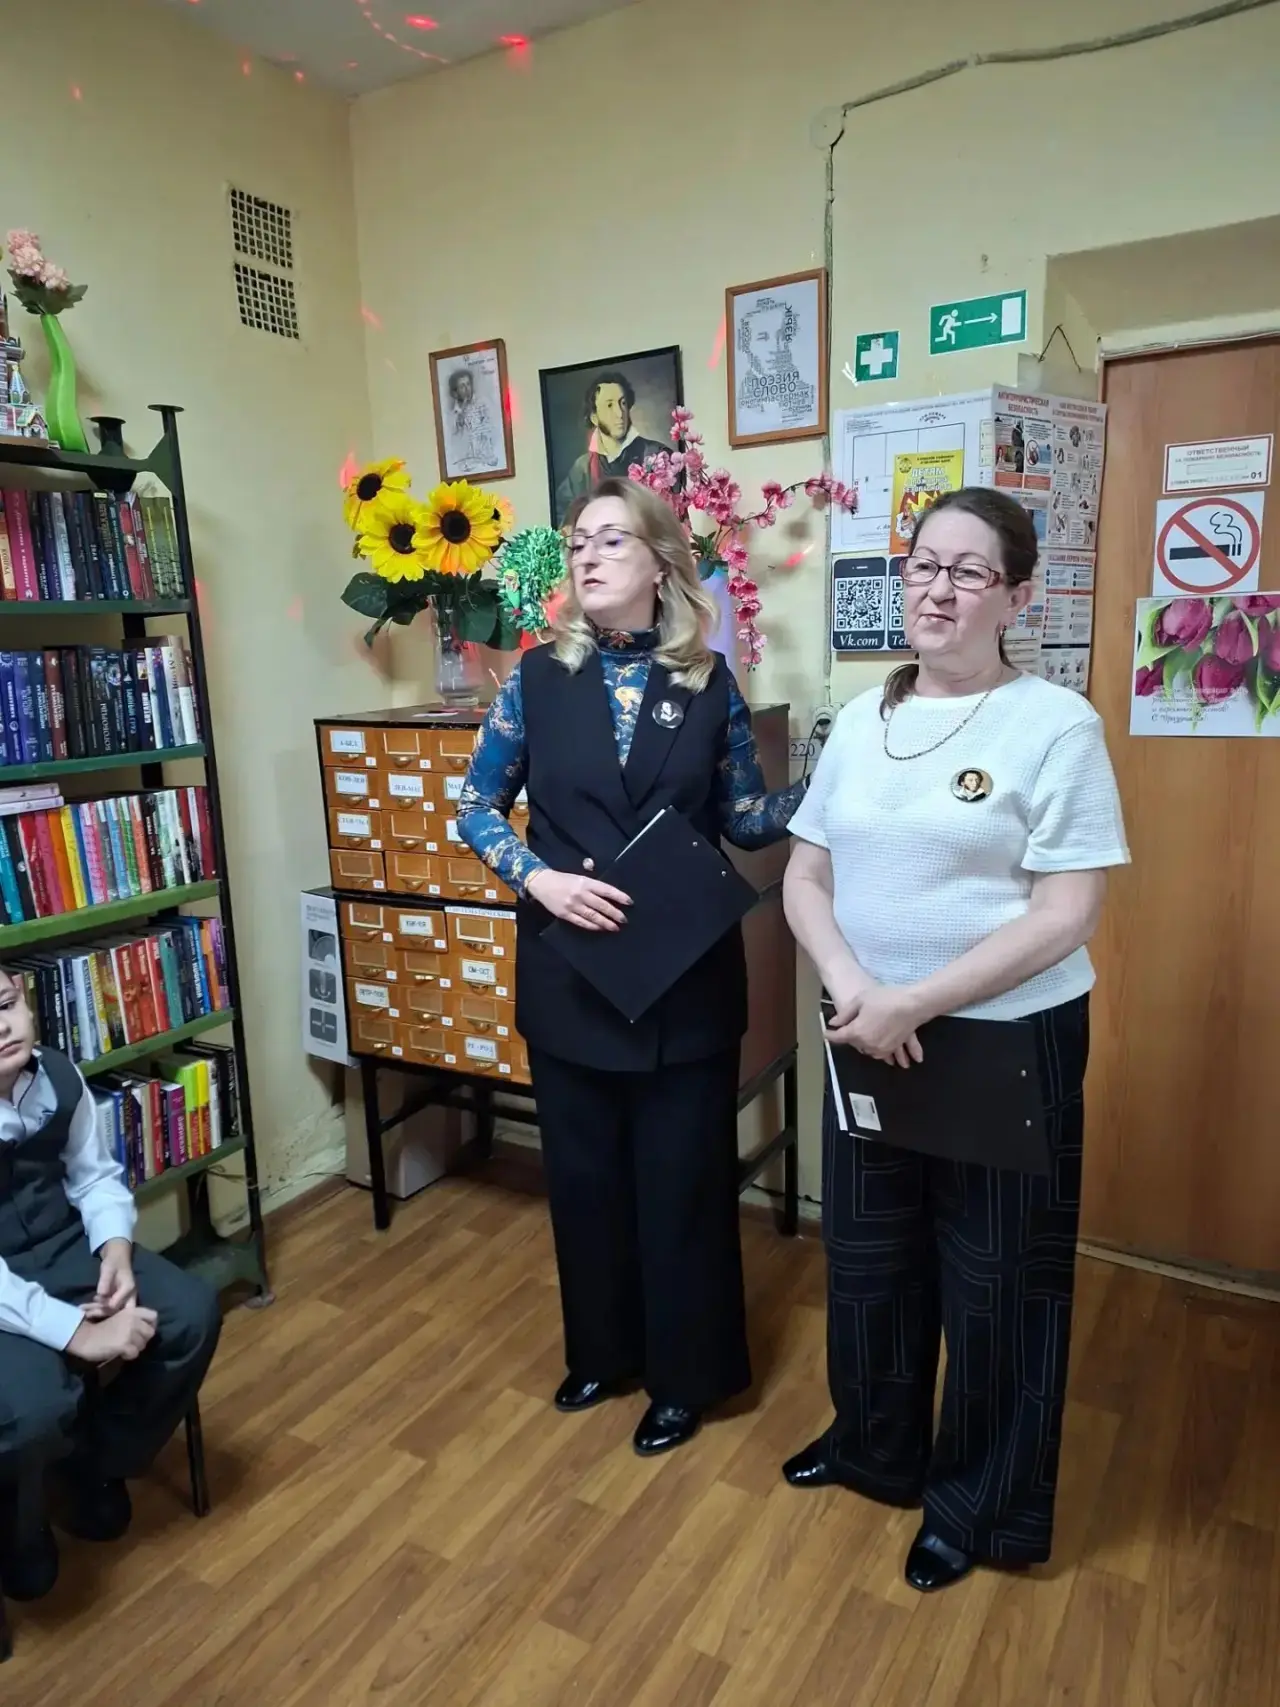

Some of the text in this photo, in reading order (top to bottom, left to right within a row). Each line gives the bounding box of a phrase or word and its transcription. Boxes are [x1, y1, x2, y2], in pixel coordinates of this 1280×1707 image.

[1187, 444, 1249, 456] ОТВЕТСТВЕННЫЙ
[1250, 471, 1263, 480] 01
[840, 634, 878, 646] Vk.com
[791, 743, 815, 756] 220
